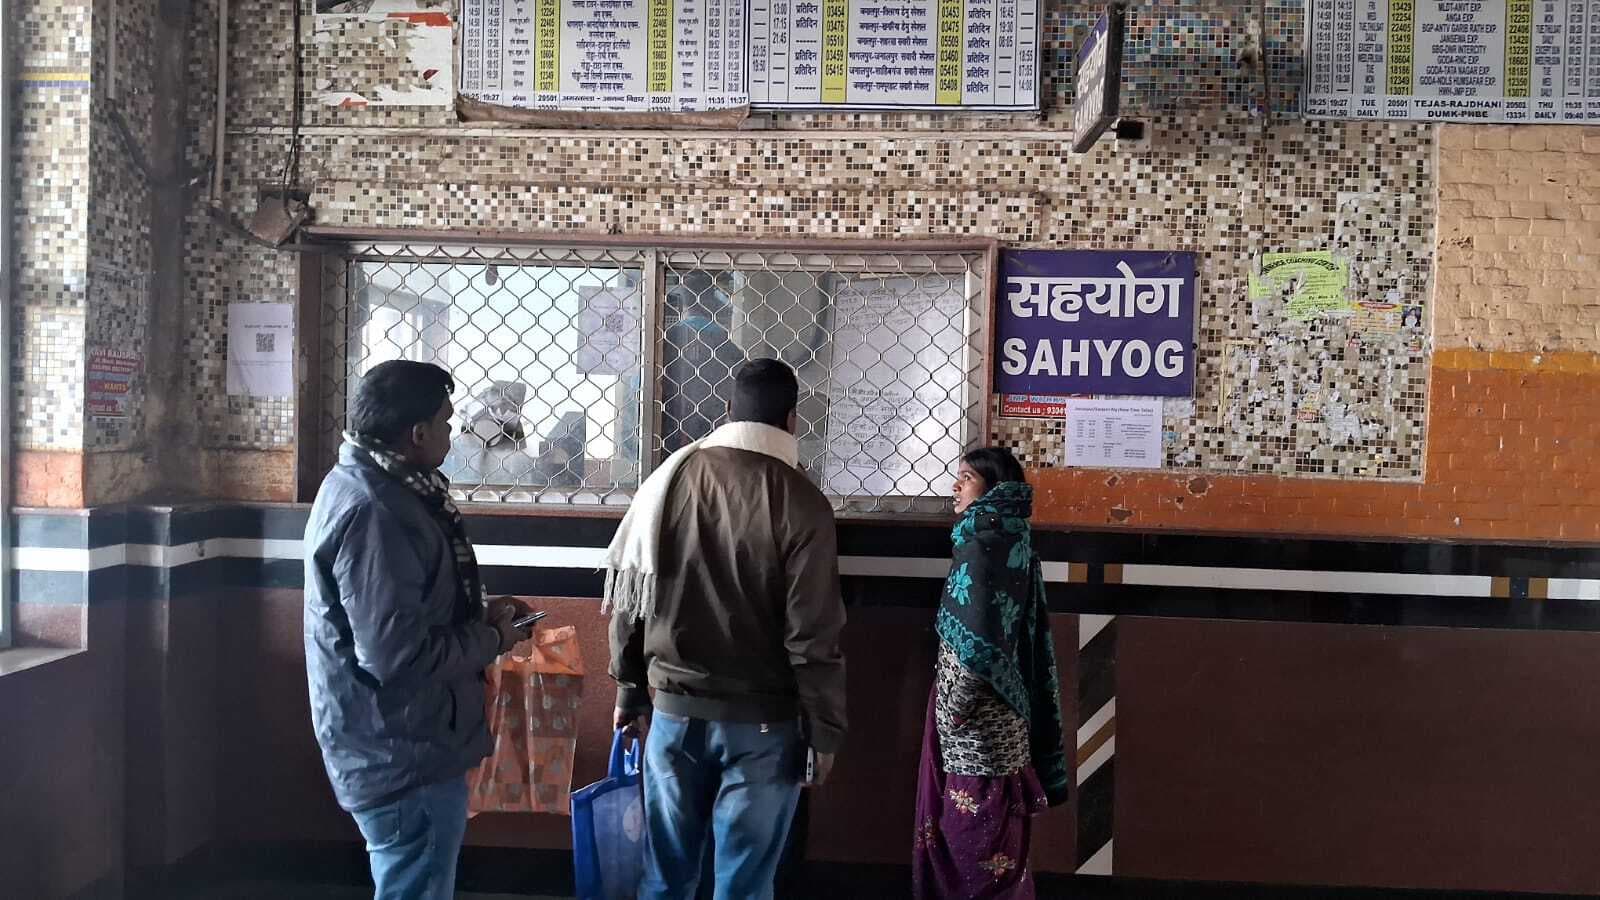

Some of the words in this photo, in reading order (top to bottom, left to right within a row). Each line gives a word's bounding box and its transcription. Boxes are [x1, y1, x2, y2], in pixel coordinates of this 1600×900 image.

[541, 8, 554, 16] 12254
[774, 4, 787, 14] 13:00
[796, 2, 818, 14] प्रतिदिन
[827, 6, 844, 18] 03454
[942, 6, 959, 18] 03453
[968, 8, 992, 19] प्रतिदिन
[1392, 3, 1411, 11] 13429
[1392, 13, 1411, 21] 12254
[774, 18, 786, 29] 17:15
[796, 17, 817, 28] प्रतिदिन
[942, 21, 959, 32] 03475
[968, 22, 991, 34] प्रतिदिन
[1392, 24, 1411, 32] 22405
[773, 32, 786, 44] 21:45
[968, 37, 990, 48] प्रतिदिन
[1392, 34, 1411, 42] 13419
[1391, 45, 1410, 53] 13235
[795, 50, 817, 61] प्रतिदिन
[967, 52, 990, 63] प्रतिदिन
[794, 64, 816, 75] प्रतिदिन
[826, 64, 843, 76] 05415
[967, 66, 989, 78] प्रतिदिन
[966, 82, 989, 93] प्रतिदिन
[1415, 100, 1501, 108] TEJAS-RAJDHANI
[1007, 260, 1184, 322] सहयोग
[1002, 338, 1184, 378] SAHYOG
[1004, 404, 1030, 414] Contact
